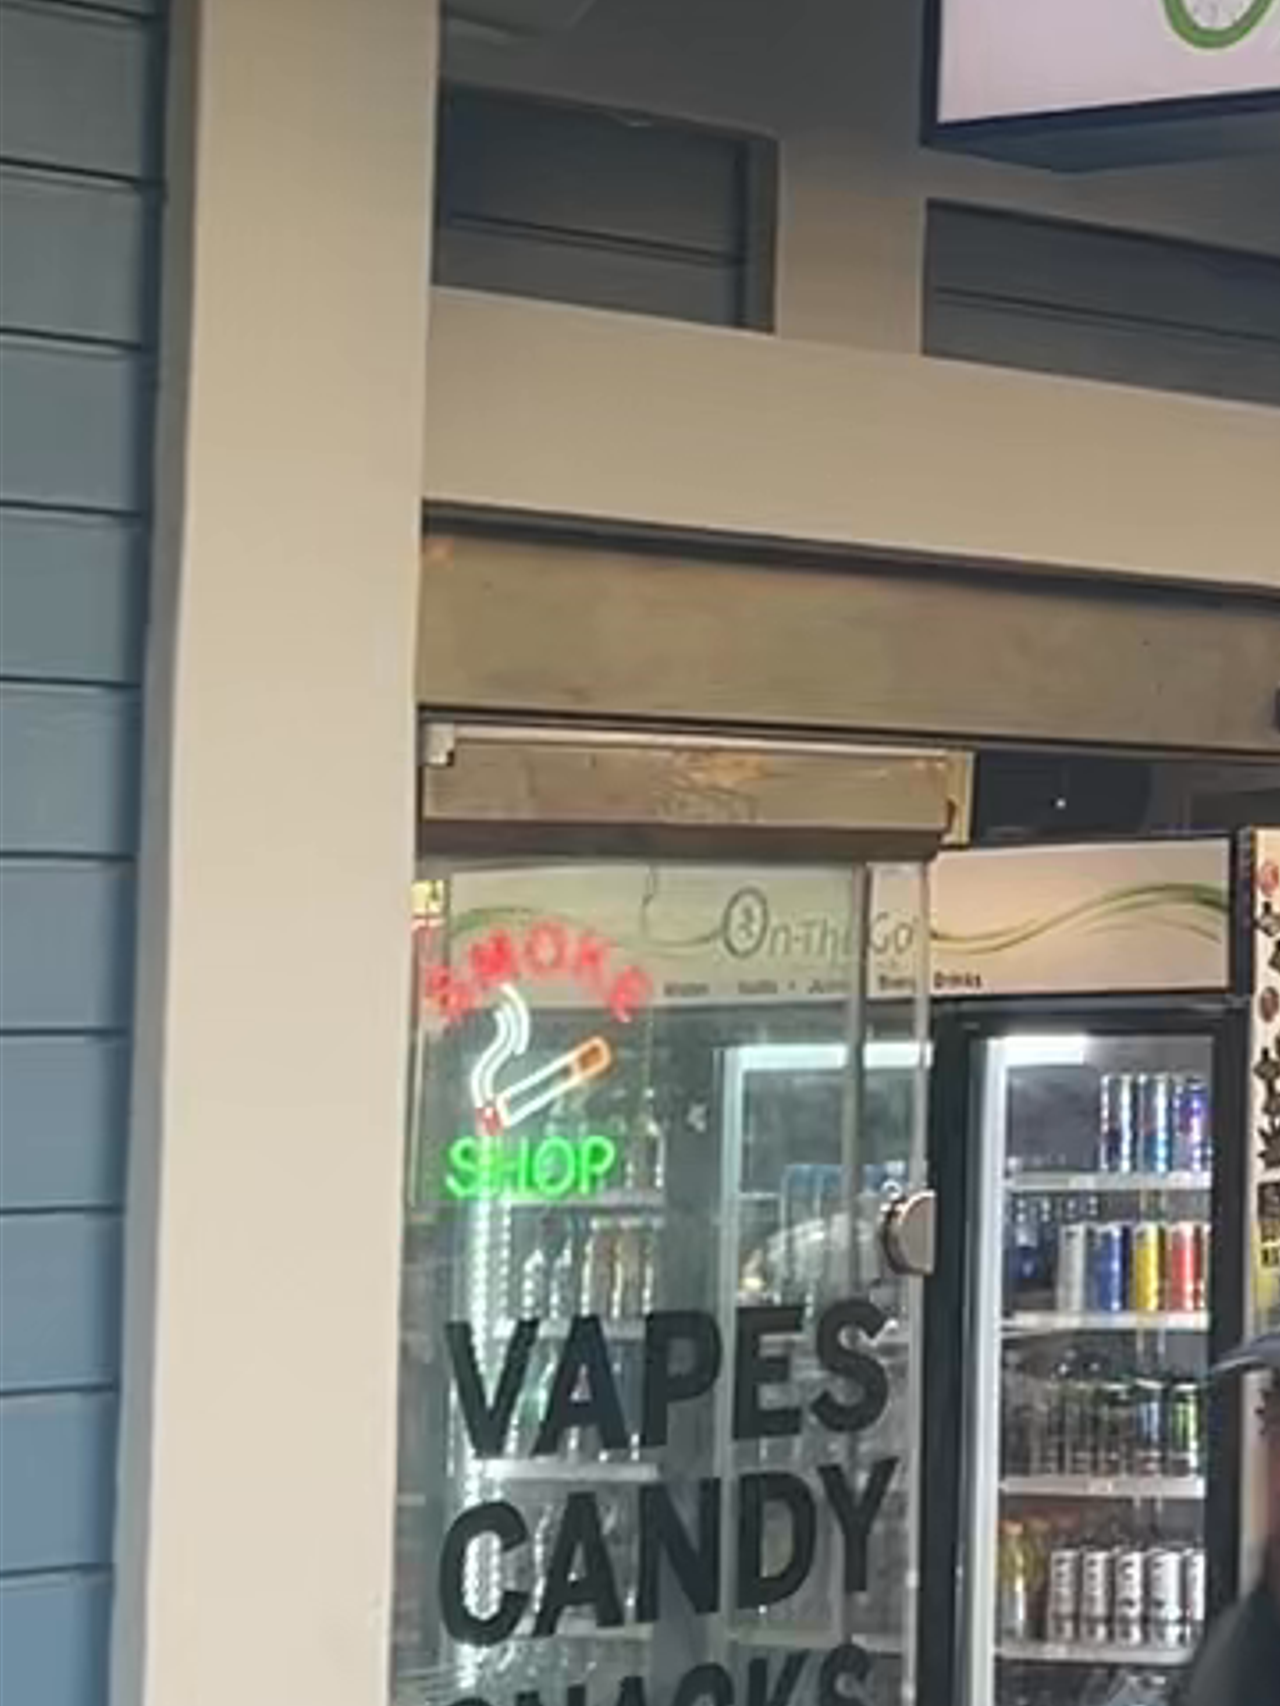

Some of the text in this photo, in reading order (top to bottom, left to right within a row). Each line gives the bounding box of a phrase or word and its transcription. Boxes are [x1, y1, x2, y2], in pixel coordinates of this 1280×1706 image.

[446, 1134, 616, 1199] SHOP
[445, 1297, 893, 1460] VAPES
[438, 1456, 899, 1648] CANDY
